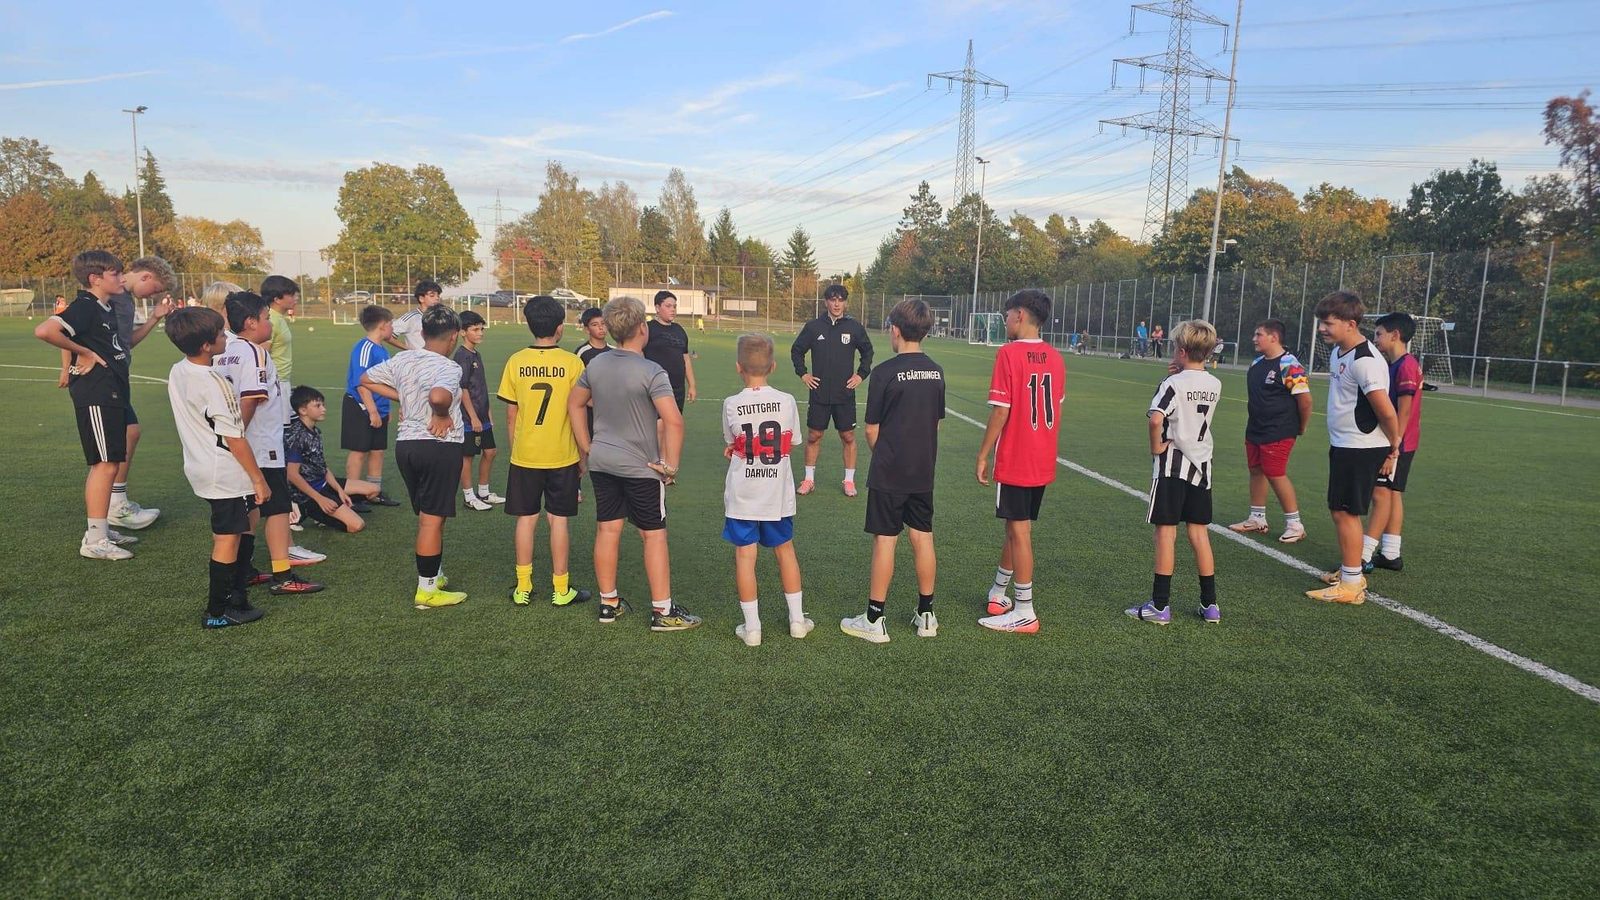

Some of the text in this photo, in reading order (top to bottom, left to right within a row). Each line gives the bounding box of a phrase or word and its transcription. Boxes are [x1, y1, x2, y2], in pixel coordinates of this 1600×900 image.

[519, 366, 566, 378] RONALDO
[897, 372, 906, 382] FC
[530, 382, 553, 425] 7
[737, 402, 781, 416] STUTTGART
[1026, 373, 1054, 431] 11
[1197, 404, 1209, 442] 7
[741, 421, 782, 465] 19
[745, 468, 778, 479] DARVICH
[207, 618, 228, 626] FILA
